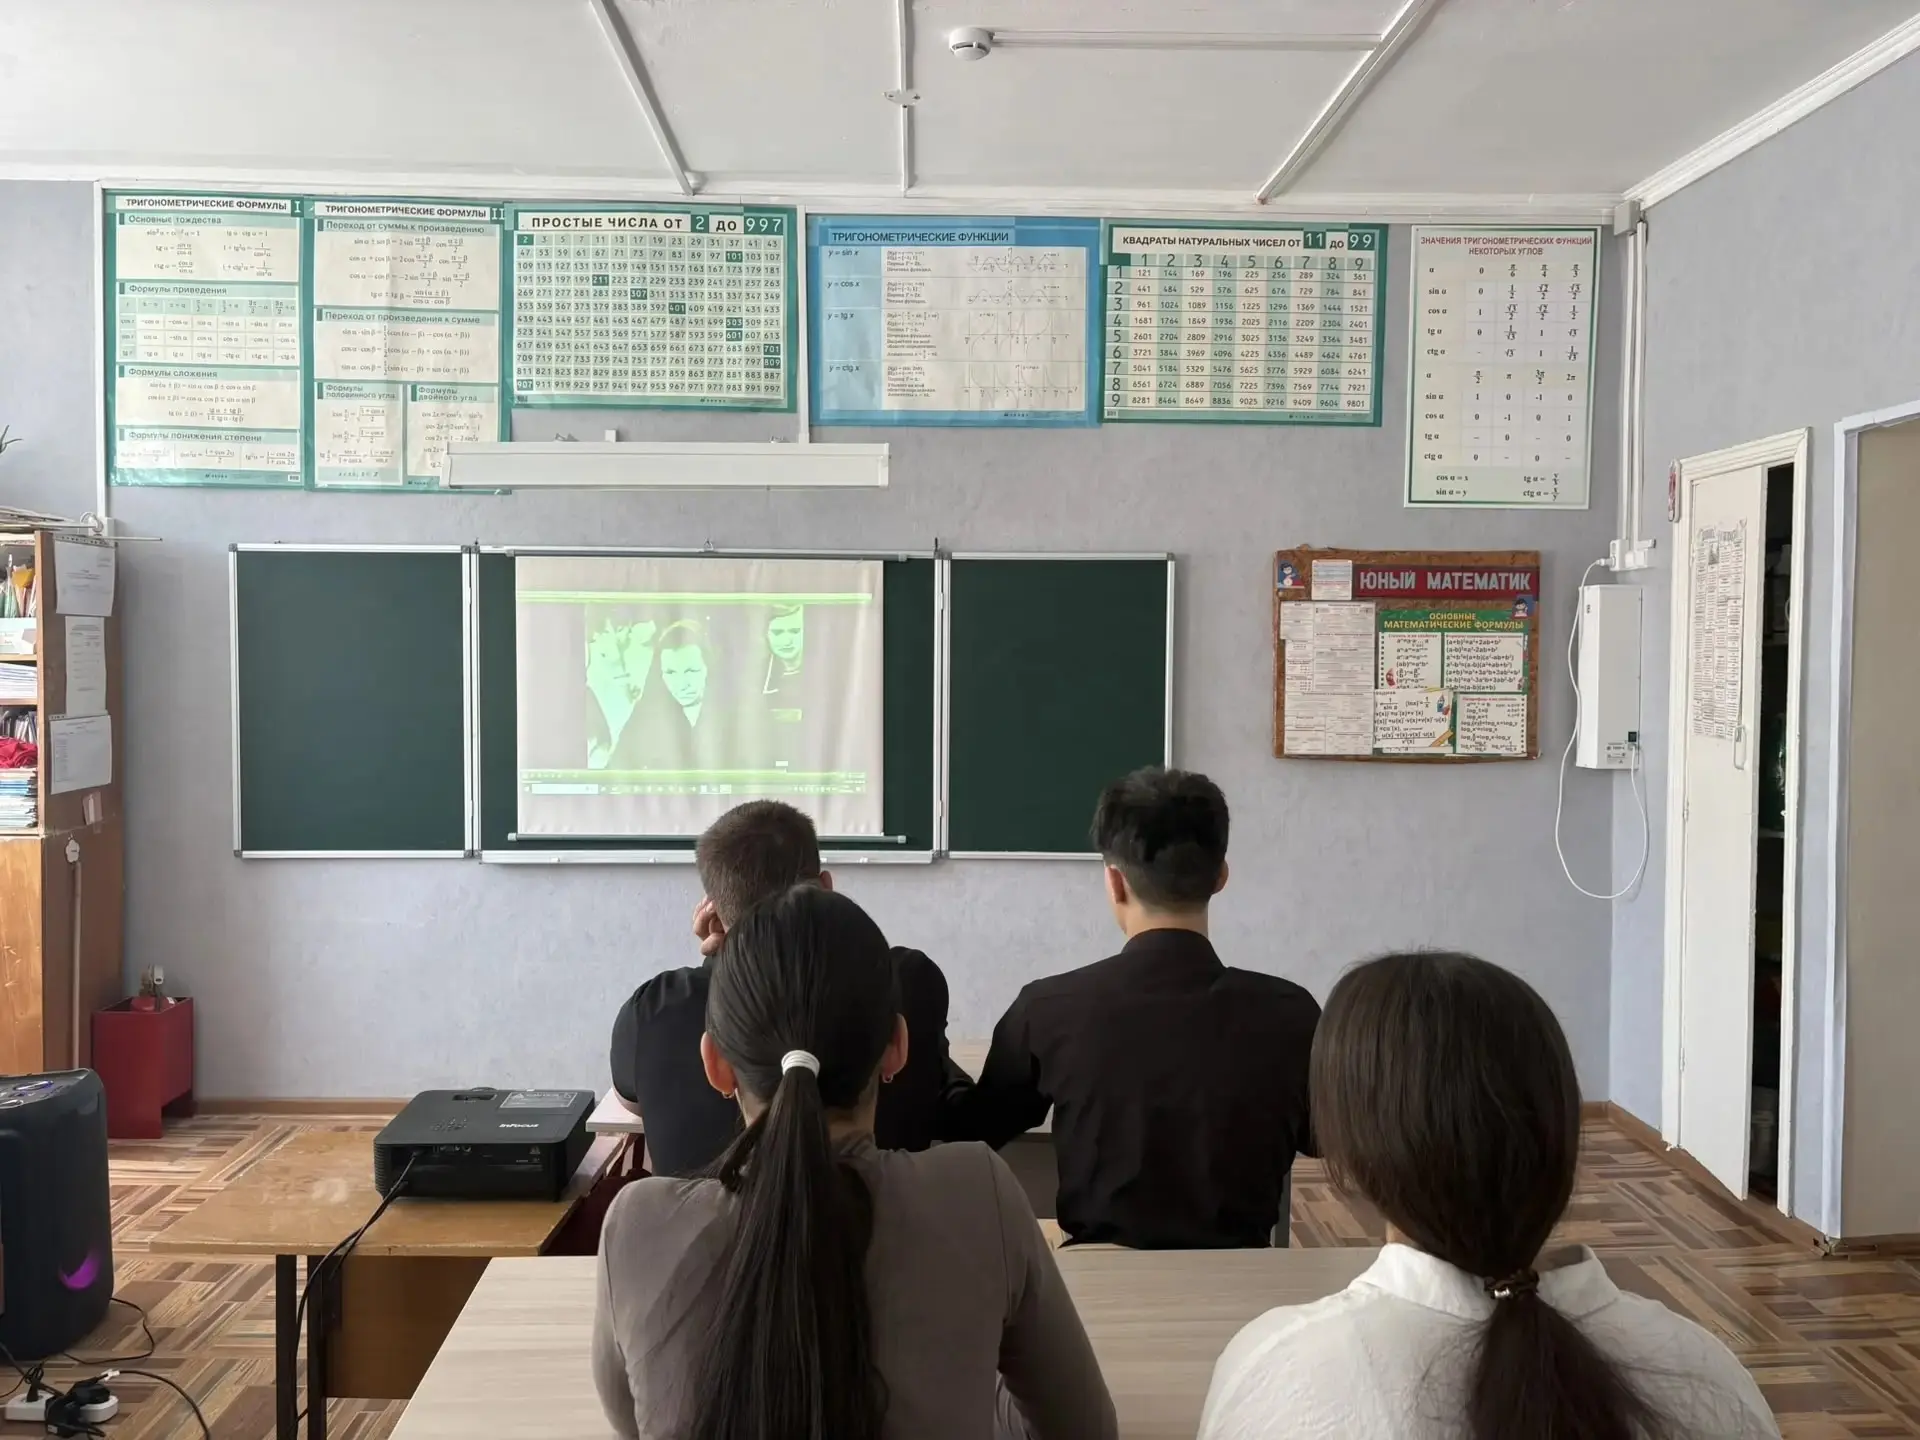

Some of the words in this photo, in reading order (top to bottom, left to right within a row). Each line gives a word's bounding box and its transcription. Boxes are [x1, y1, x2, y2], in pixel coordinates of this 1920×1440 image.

[126, 199, 234, 208] ТРИГОНОМЕТРИЧЕСКИЕ
[326, 206, 435, 215] ТРИГОНОМЕТРИЧЕСКИЕ
[437, 209, 486, 217] ФОРМУЛЫ
[327, 222, 364, 230] Переход
[418, 225, 484, 233] произведению
[532, 217, 602, 228] ПРОСТЫЕ
[608, 218, 657, 228] ЧИСЛА
[664, 218, 682, 228] ОТ
[696, 216, 704, 230] 2
[716, 221, 737, 231] ДО
[746, 218, 780, 231] 997
[523, 236, 528, 244] 2
[542, 236, 547, 244] 3
[615, 236, 624, 244] 13
[634, 236, 643, 244] 17
[672, 237, 682, 245] 23
[691, 238, 701, 246] 29
[729, 239, 739, 247] 37
[748, 240, 758, 248] 41
[767, 240, 777, 248] 43
[832, 232, 955, 242] ТРИГОНОМЕТРИЧЕСКИЕ
[958, 233, 1009, 242] ФУНКЦИИ
[1123, 236, 1175, 245] КВАДРАТЫ
[1178, 237, 1250, 247] НАТУРАЛЬНЫХ
[1253, 238, 1286, 247] ЧИСЕЛ
[1288, 239, 1301, 247] ОТ
[1305, 233, 1323, 247] 11
[1330, 240, 1344, 248] ДО
[1350, 234, 1372, 247] 99
[1421, 237, 1461, 245] ЗНАЧЕНИЯ
[1464, 237, 1554, 245] ТРИГОНОМЕТРИЧЕСКИХ
[1556, 236, 1592, 245] ФУНКЦИЙ
[1469, 247, 1516, 256] НЕКОТОРЫХ
[1517, 247, 1543, 256] УГЛОВ
[1141, 253, 1147, 267] 1
[1167, 254, 1175, 267] 2
[1194, 254, 1202, 267] 3
[1220, 255, 1229, 268] 4
[1247, 255, 1256, 268] 5
[1275, 256, 1283, 269] 6
[1302, 256, 1310, 269] 7
[1328, 257, 1337, 270] 8
[1355, 258, 1363, 271] 9
[1116, 266, 1123, 278] 1
[1137, 269, 1151, 277] 121
[1191, 270, 1205, 278] 169
[1245, 271, 1258, 279] 225
[1299, 272, 1312, 280] 289
[1353, 273, 1366, 281] 361
[326, 312, 363, 321] Переход
[378, 314, 442, 323] произведения
[1113, 330, 1121, 342] 5
[1160, 333, 1178, 341] 2704
[1214, 334, 1232, 342] 2916
[1268, 335, 1286, 343] 3136
[1322, 336, 1340, 344] 3364
[129, 369, 171, 377] Формулы
[574, 381, 590, 389] 929
[593, 381, 608, 389] 937
[612, 381, 627, 389] 941
[669, 382, 685, 390] 967
[707, 383, 723, 391] 977
[726, 383, 742, 391] 983
[764, 384, 780, 392] 997
[1112, 394, 1120, 406] 9
[1159, 397, 1177, 405] 8464
[1213, 398, 1231, 406] 8836
[1293, 399, 1311, 407] 9409
[1347, 400, 1365, 408] 9801
[1360, 571, 1415, 589] ЮНЫЙ
[1427, 572, 1530, 590] МАТЕМАТИК
[1429, 612, 1475, 620] ОСНОВНЫЕ
[1384, 620, 1472, 629] МАТЕМАТИЧЕСКИЕ
[1475, 621, 1524, 630] ФОРМУЛЫ
